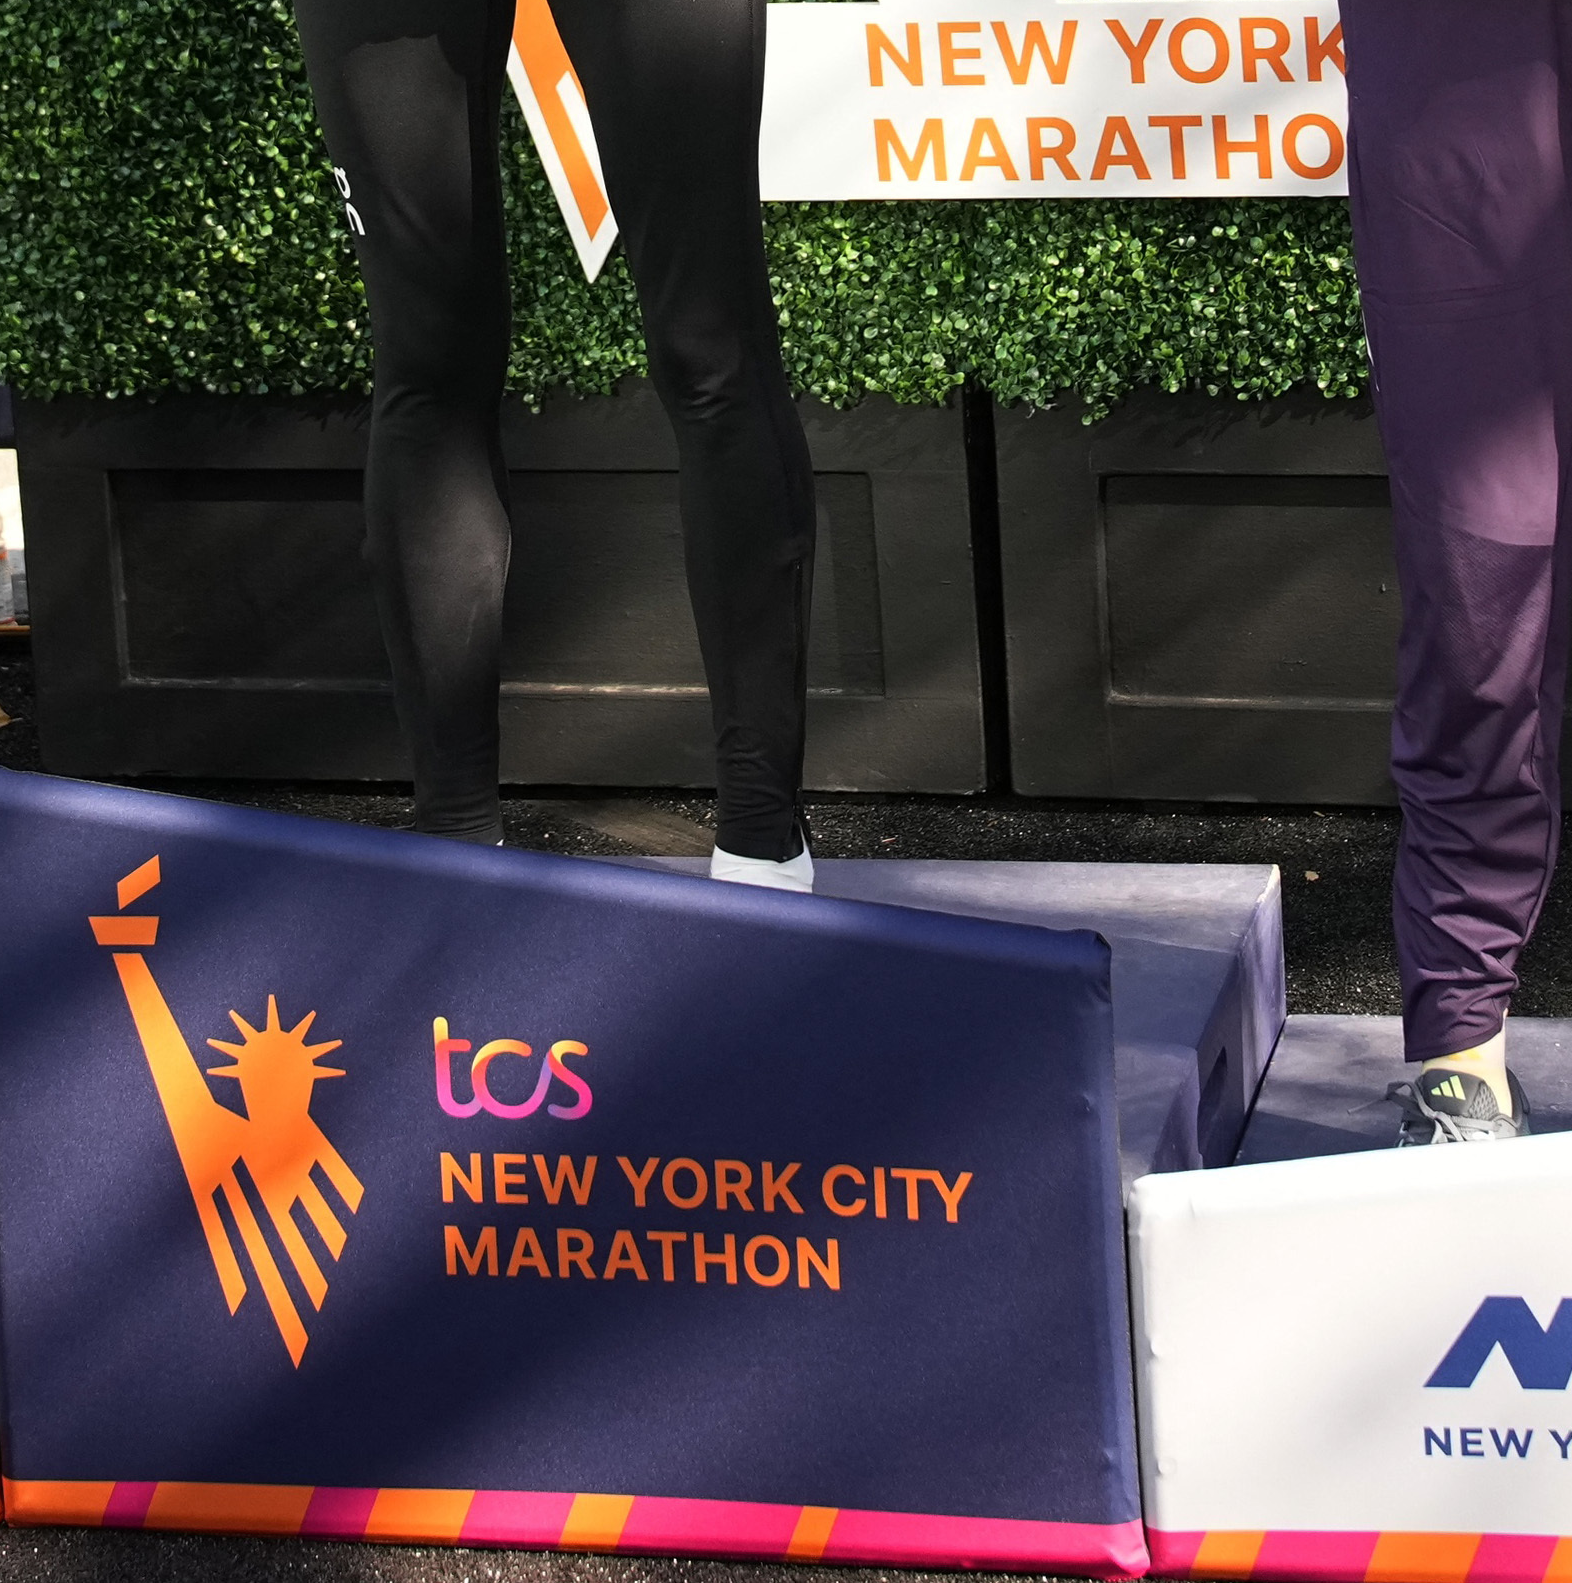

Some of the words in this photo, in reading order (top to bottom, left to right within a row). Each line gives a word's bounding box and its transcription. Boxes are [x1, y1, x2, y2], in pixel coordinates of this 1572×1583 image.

[865, 20, 1078, 88] NEW
[1104, 16, 1347, 83] YORK
[873, 113, 1345, 183] MARATHO
[432, 1015, 593, 1120] tcs
[439, 1151, 597, 1206] NEW
[616, 1155, 805, 1215] YORK
[823, 1164, 974, 1224] CITY
[443, 1226, 843, 1291] MARATHON
[1422, 1425, 1534, 1460] NEW
